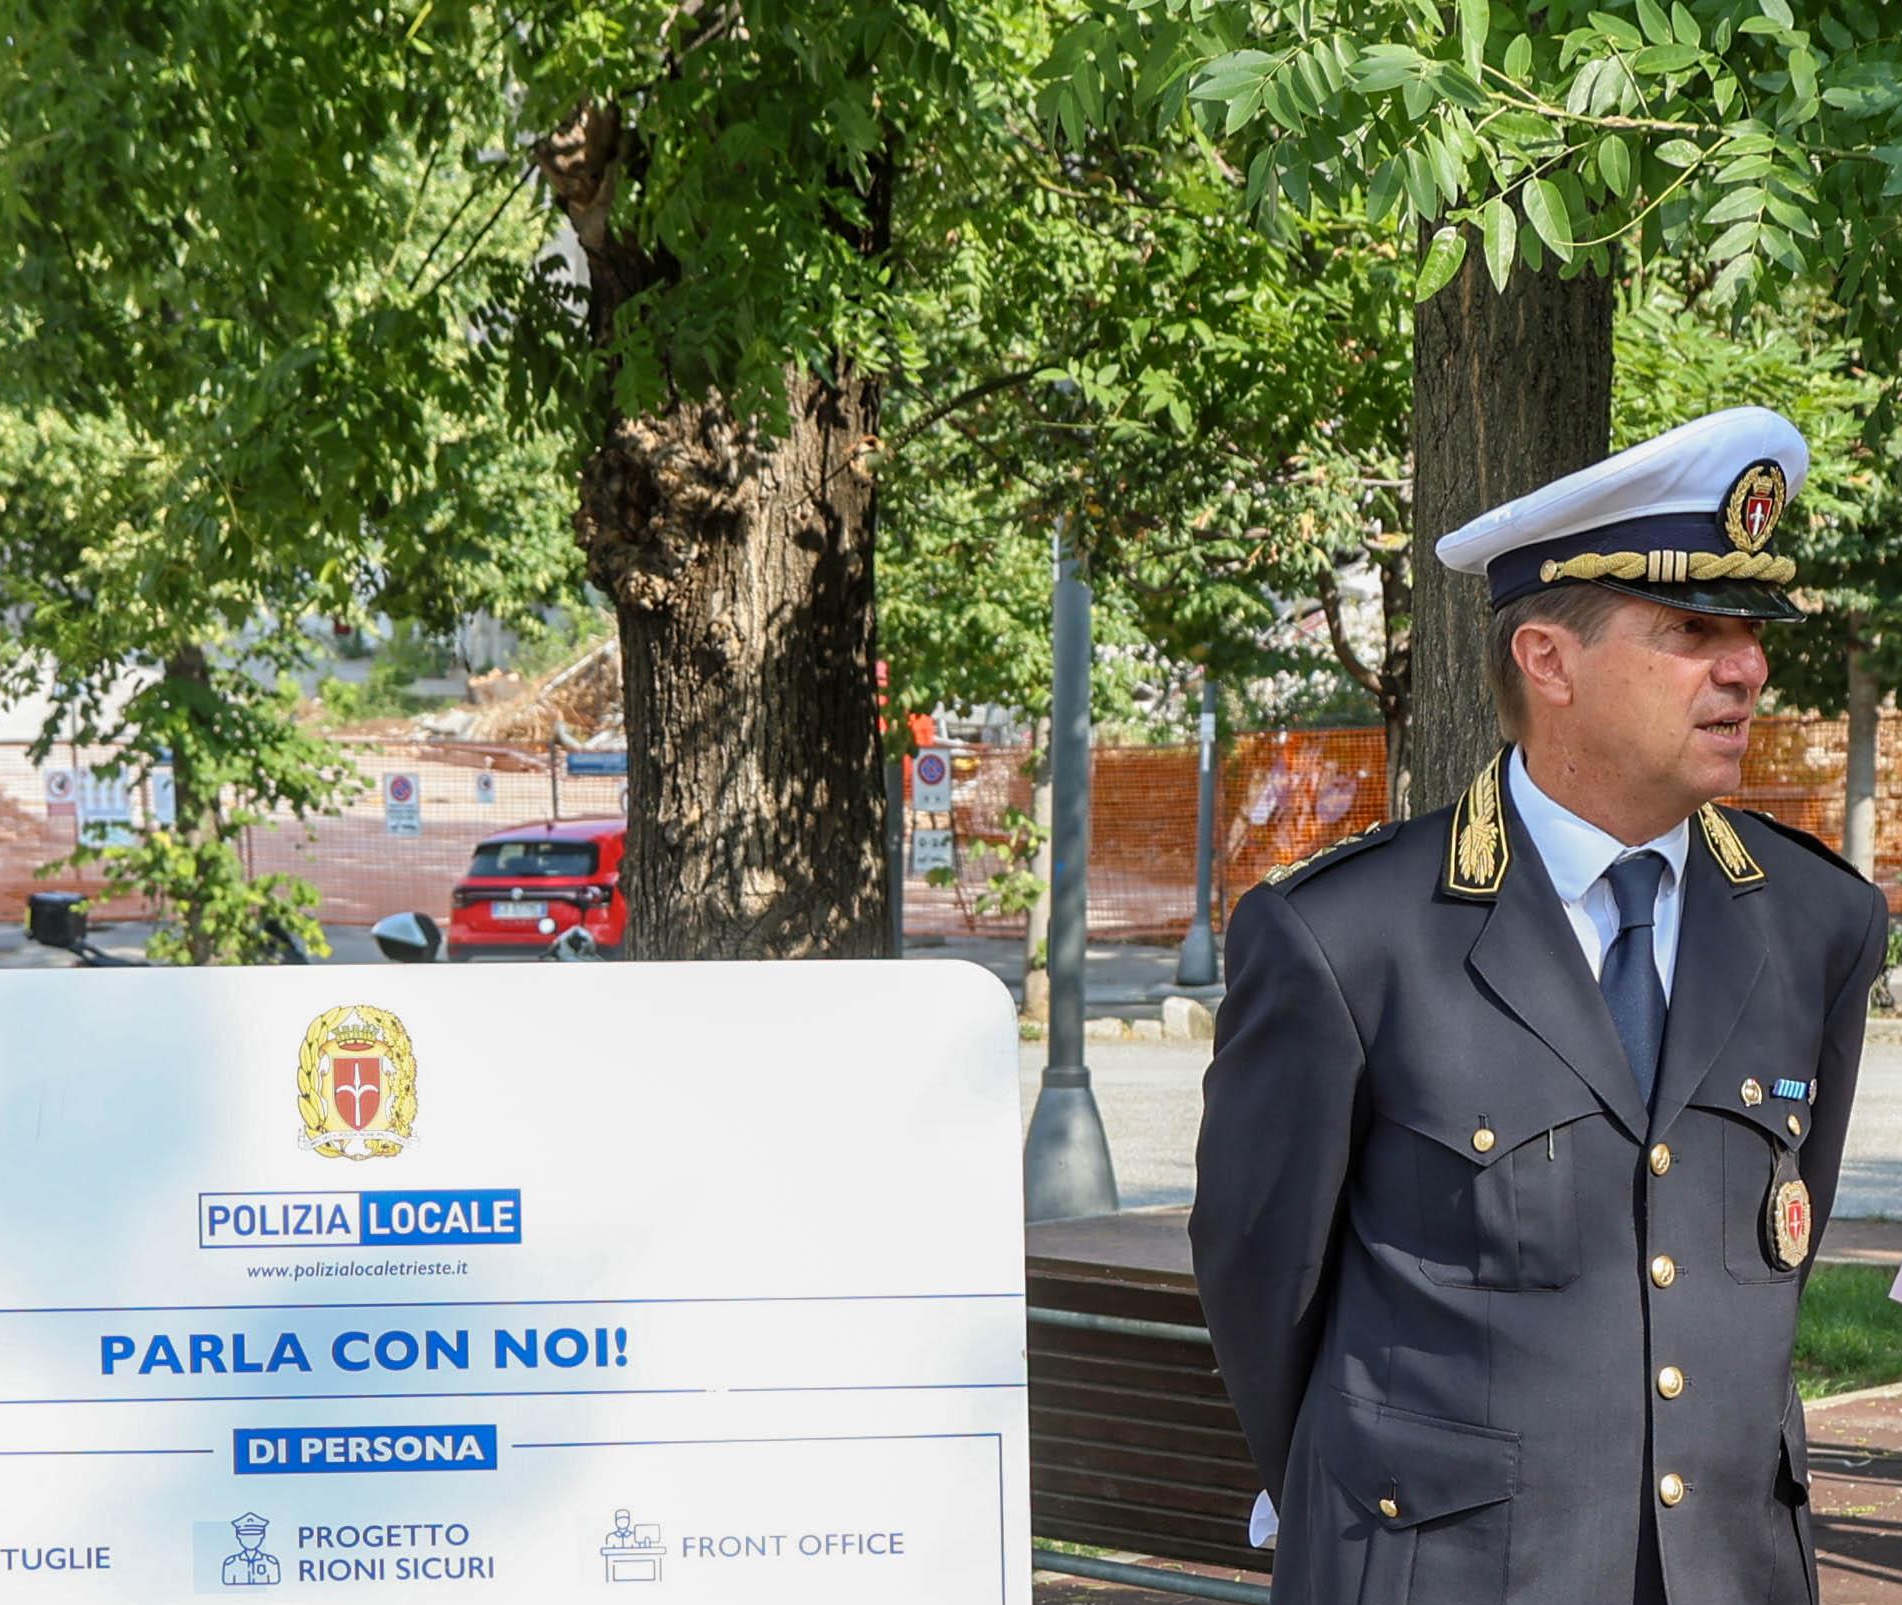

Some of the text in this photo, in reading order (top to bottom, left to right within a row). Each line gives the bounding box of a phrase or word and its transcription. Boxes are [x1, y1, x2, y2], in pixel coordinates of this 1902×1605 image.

[206, 1202, 515, 1236] POLIZIA LOCALE
[247, 1260, 468, 1281] www.polizialocaletrieste.it
[101, 1326, 630, 1377] PARLA CON NOI!
[248, 1434, 484, 1464] DI PERSONA
[299, 1524, 469, 1549] PROGETTO
[683, 1533, 904, 1557] FRONT OFFICE
[299, 1557, 494, 1582] RIONI SICURI
